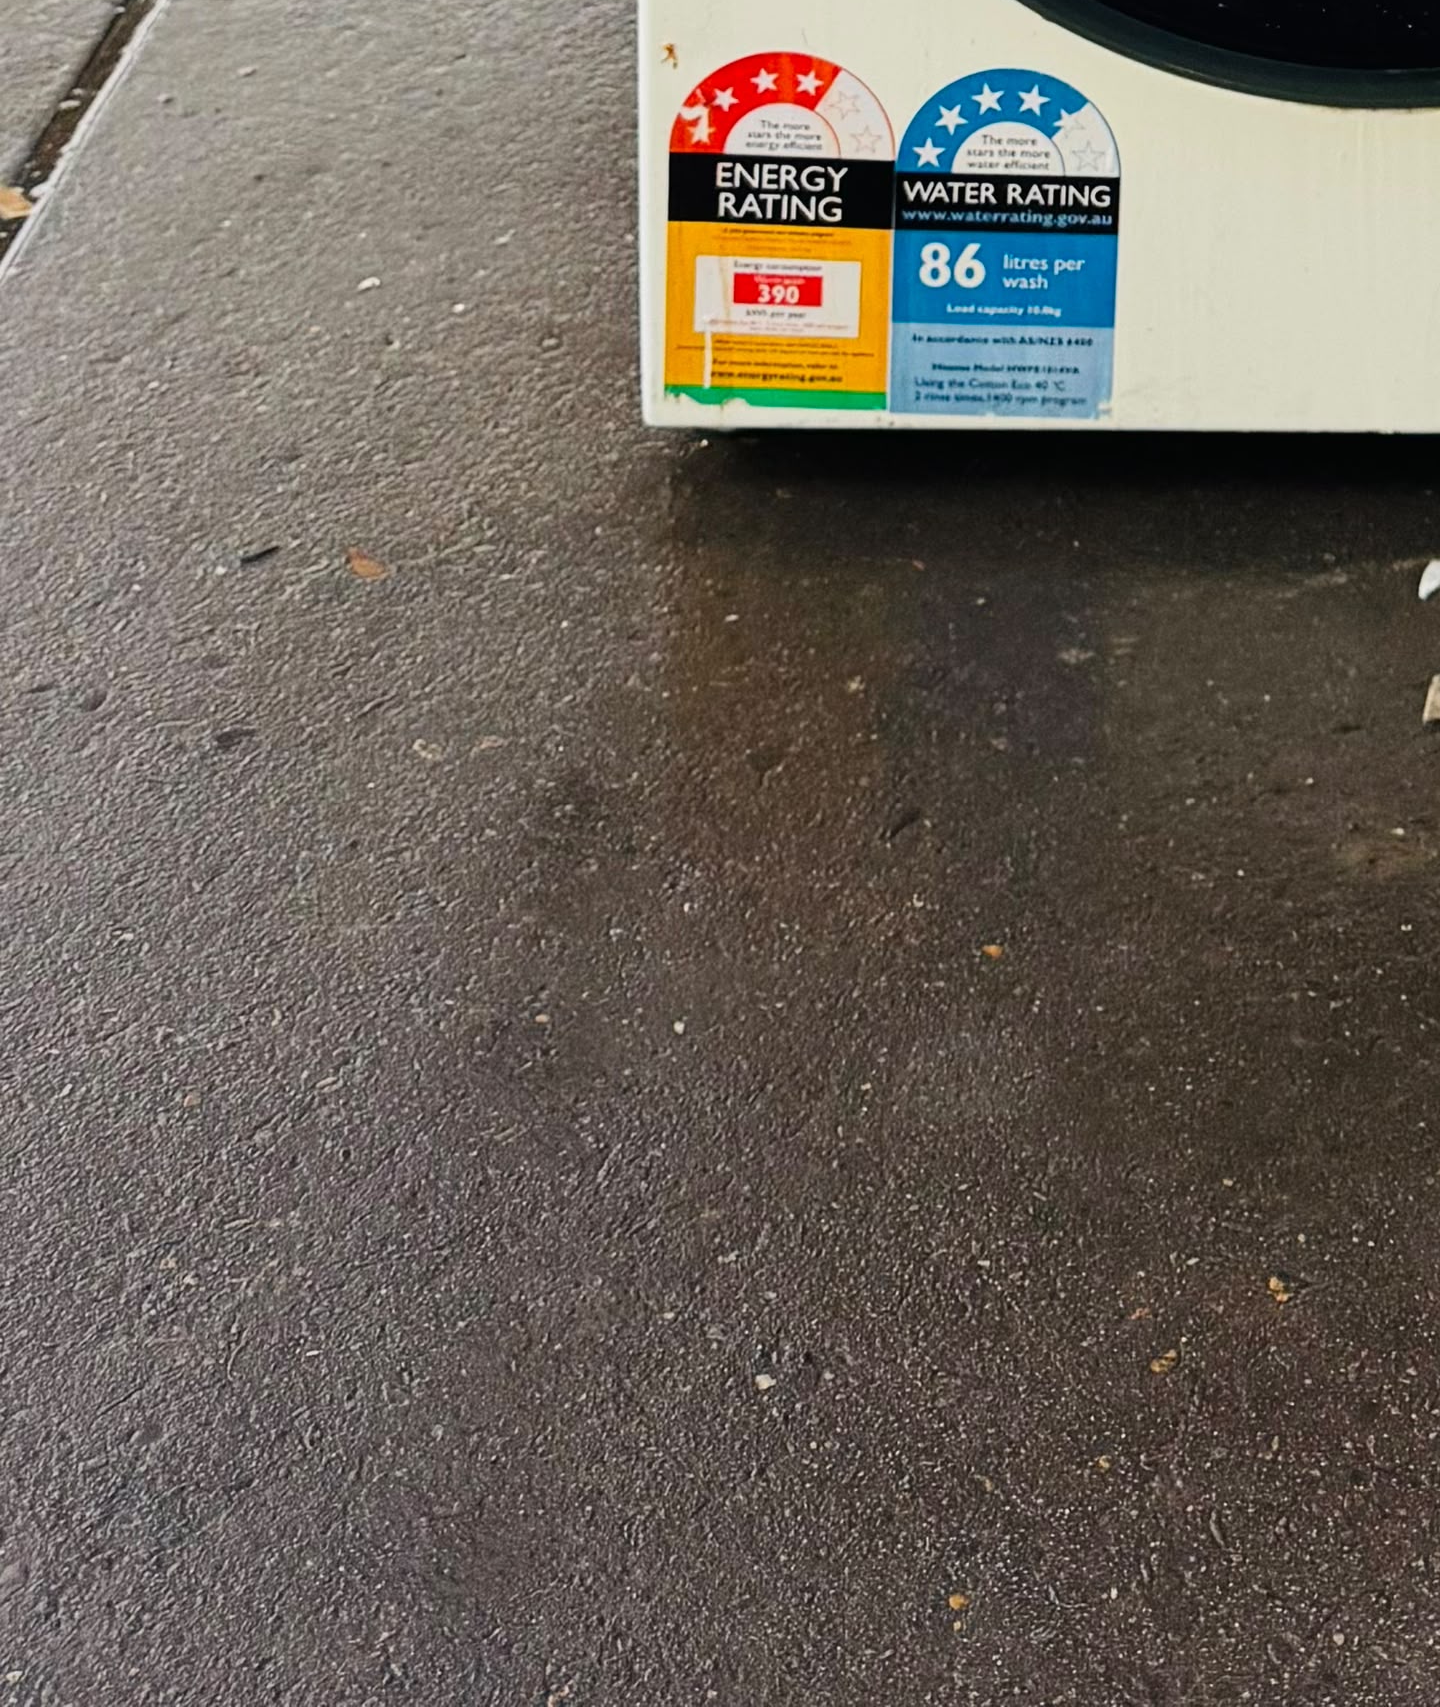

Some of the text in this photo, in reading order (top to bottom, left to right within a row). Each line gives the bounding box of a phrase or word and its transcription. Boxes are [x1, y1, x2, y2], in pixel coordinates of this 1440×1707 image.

[760, 119, 780, 129] The
[981, 134, 1038, 146] The more
[715, 161, 849, 193] ENERGY
[902, 179, 1112, 208] WATER RATING
[717, 191, 843, 223] RATING
[901, 208, 1113, 228] www.waterrating.gov.au
[918, 241, 987, 289] 86
[1002, 253, 1086, 276] litres per
[1001, 272, 1049, 291] wash
[757, 283, 800, 305] 390
[946, 303, 976, 314] Load
